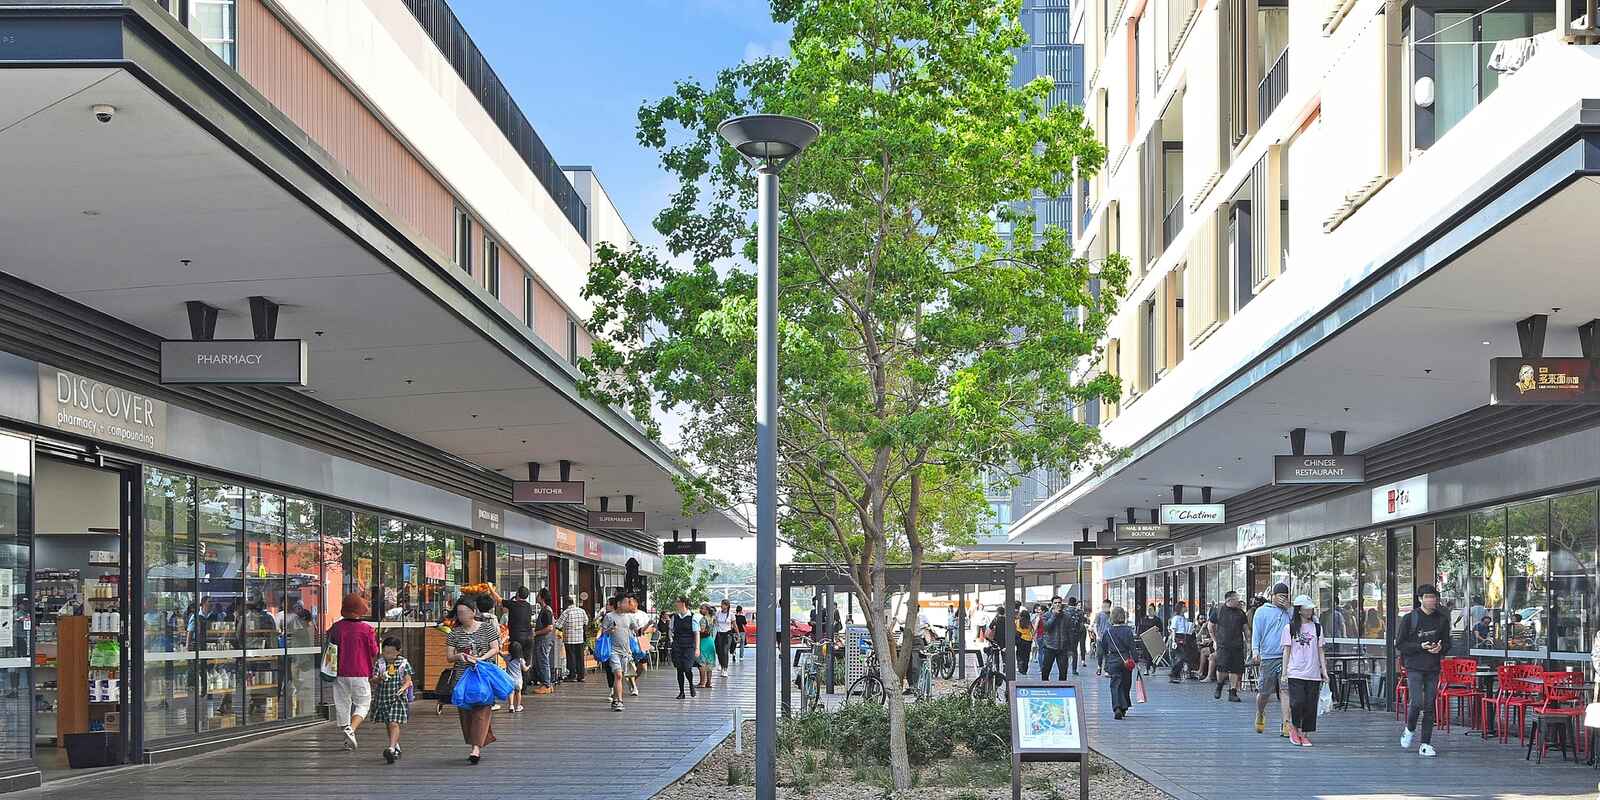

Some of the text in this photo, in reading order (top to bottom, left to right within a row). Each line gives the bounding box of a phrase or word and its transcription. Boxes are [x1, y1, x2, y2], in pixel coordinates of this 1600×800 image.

[197, 354, 263, 365] PHARMACY
[57, 371, 154, 427] DISCOVER
[57, 407, 97, 433] pharmacy
[108, 425, 154, 448] compounding
[1304, 459, 1336, 467] CHINESE
[1295, 468, 1345, 476] RESTAURANT
[533, 487, 563, 495] BUTCHER
[1179, 510, 1217, 520] Chatime
